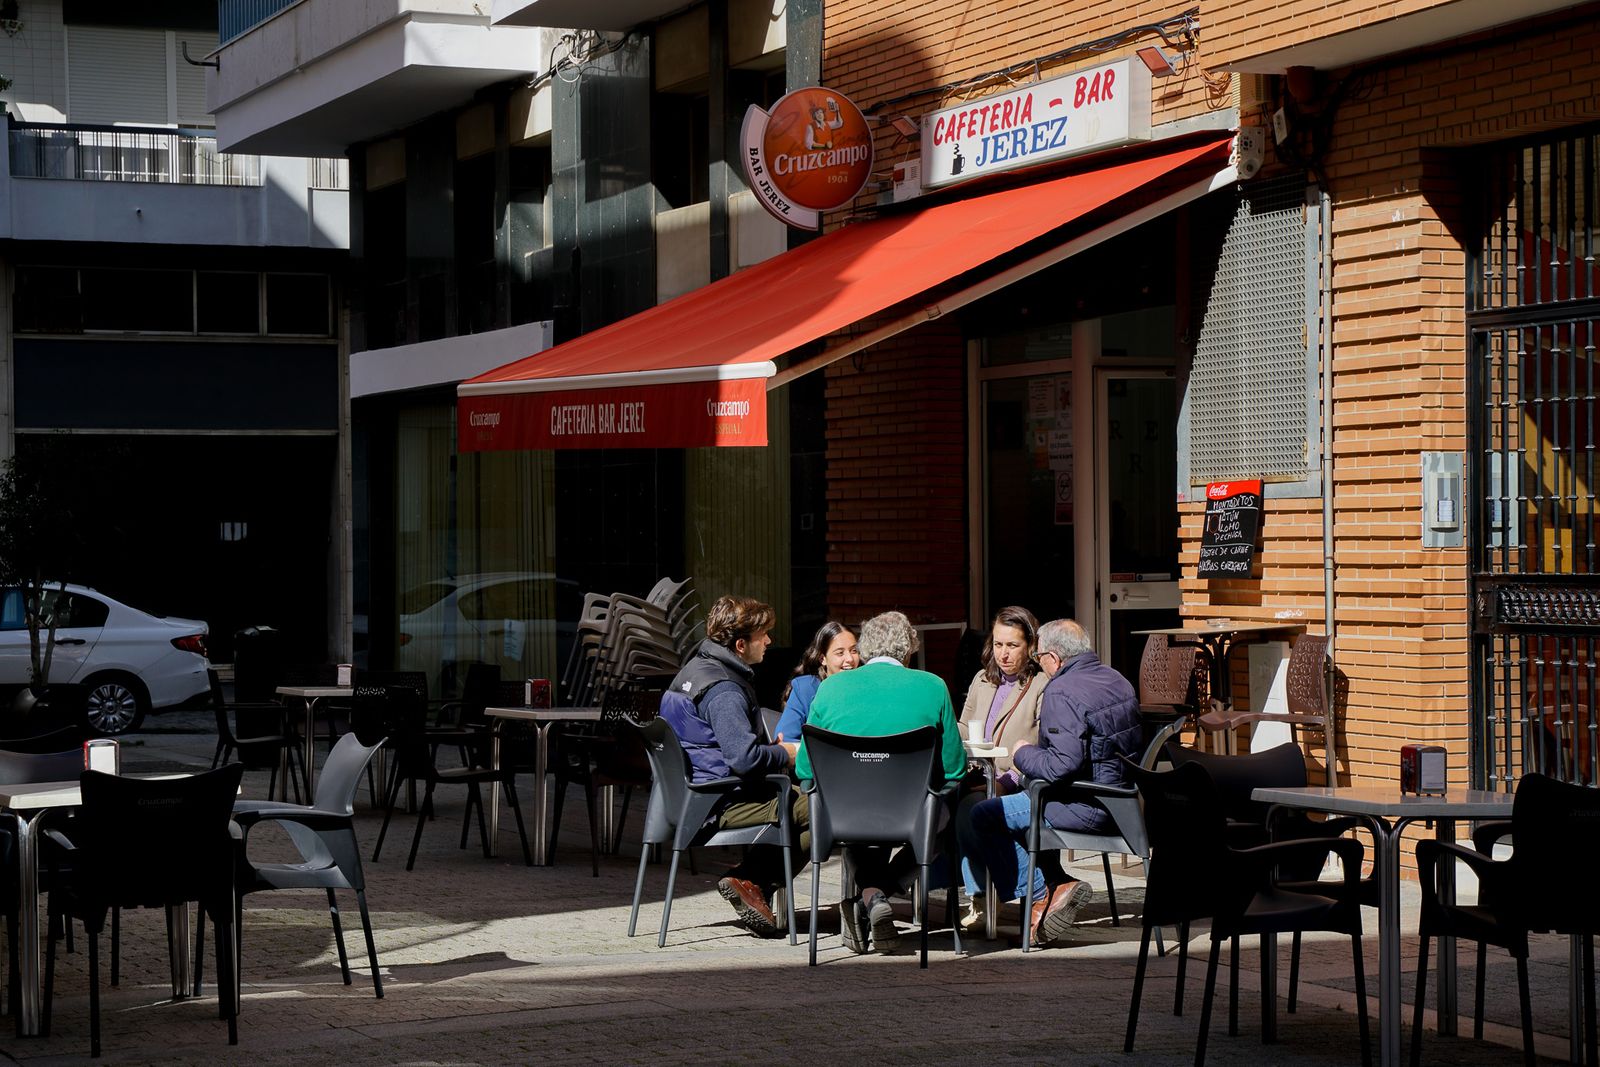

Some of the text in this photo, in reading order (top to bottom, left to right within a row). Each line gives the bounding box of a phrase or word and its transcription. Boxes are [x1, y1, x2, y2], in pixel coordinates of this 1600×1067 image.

[933, 92, 1033, 146] CAFETERIA
[1073, 68, 1116, 110] BAR
[975, 116, 1068, 167] JEREZ
[774, 143, 868, 176] Cruzcampo
[749, 147, 791, 215] BAR JEREZ
[470, 411, 501, 429] Cruzcampo
[550, 401, 646, 435] CAFETERIA BAR JEREZ
[707, 398, 750, 419] Cruzcampo
[852, 751, 890, 759] Cruzcampo
